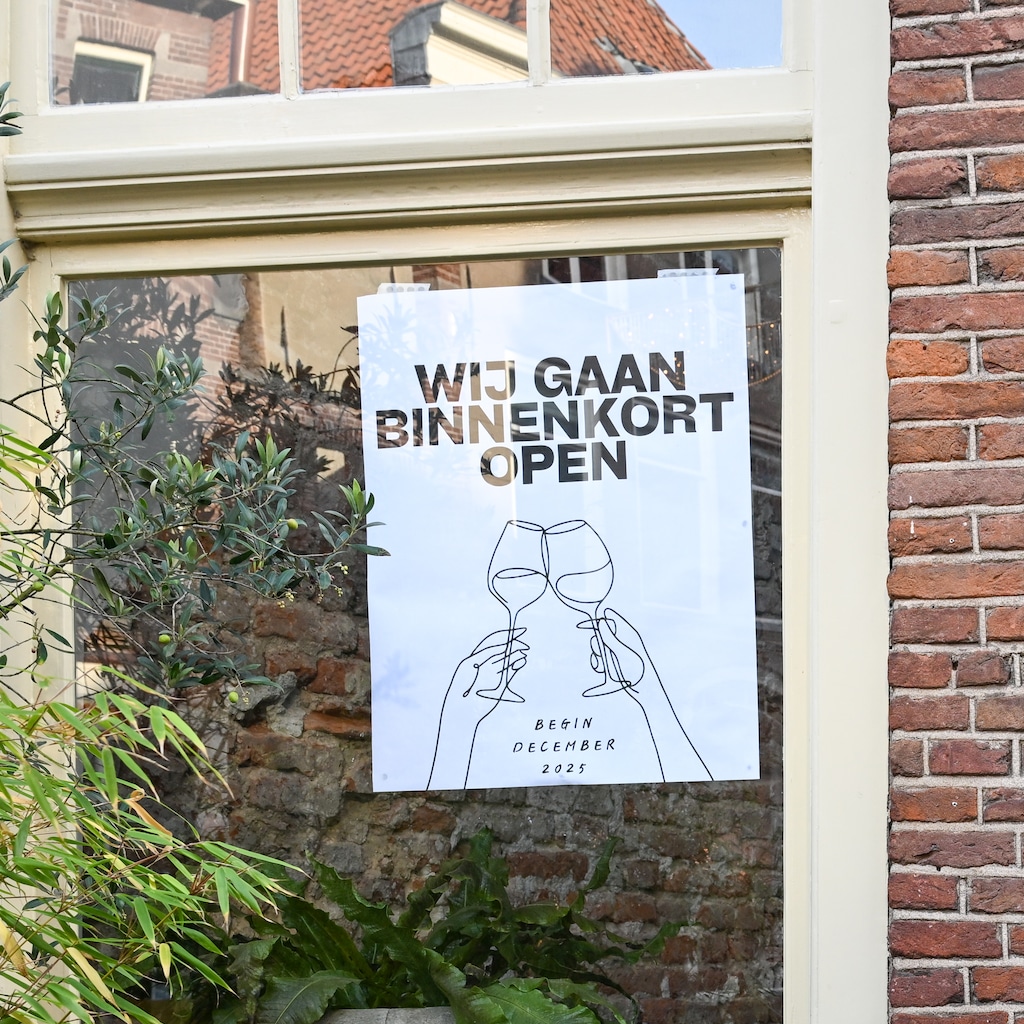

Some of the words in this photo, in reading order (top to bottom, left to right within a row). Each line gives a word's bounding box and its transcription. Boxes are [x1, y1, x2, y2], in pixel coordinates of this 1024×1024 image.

[414, 360, 516, 404] WIJ
[533, 350, 686, 398] GAAN
[376, 392, 734, 449] BINNENKORT
[480, 440, 628, 487] OPEN
[534, 717, 593, 730] BEGIN
[512, 738, 616, 753] DECEMBER
[541, 763, 587, 774] 2025
